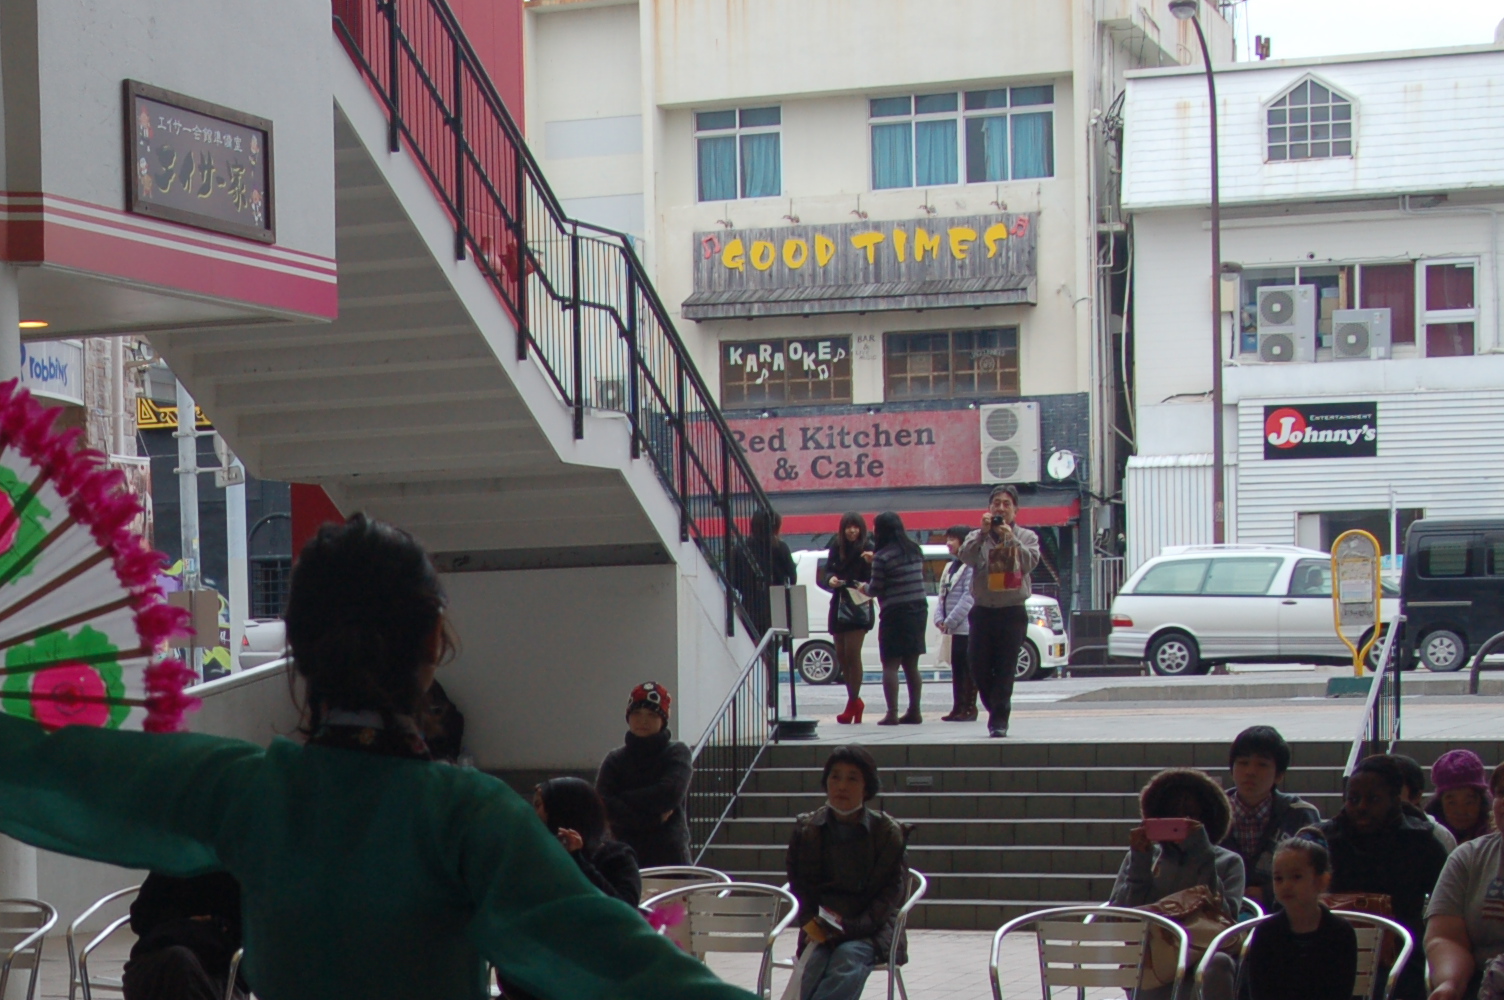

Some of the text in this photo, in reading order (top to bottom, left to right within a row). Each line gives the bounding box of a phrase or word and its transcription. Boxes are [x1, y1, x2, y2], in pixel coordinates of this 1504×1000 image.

[722, 222, 1008, 273] GOOD TIMES
[857, 334, 876, 343] BAR
[29, 352, 69, 387] robbins
[729, 341, 832, 373] KARAOKE
[731, 423, 936, 454] Red Kitchen
[1267, 416, 1376, 446] Johnny's
[773, 453, 885, 481] & Cafe
